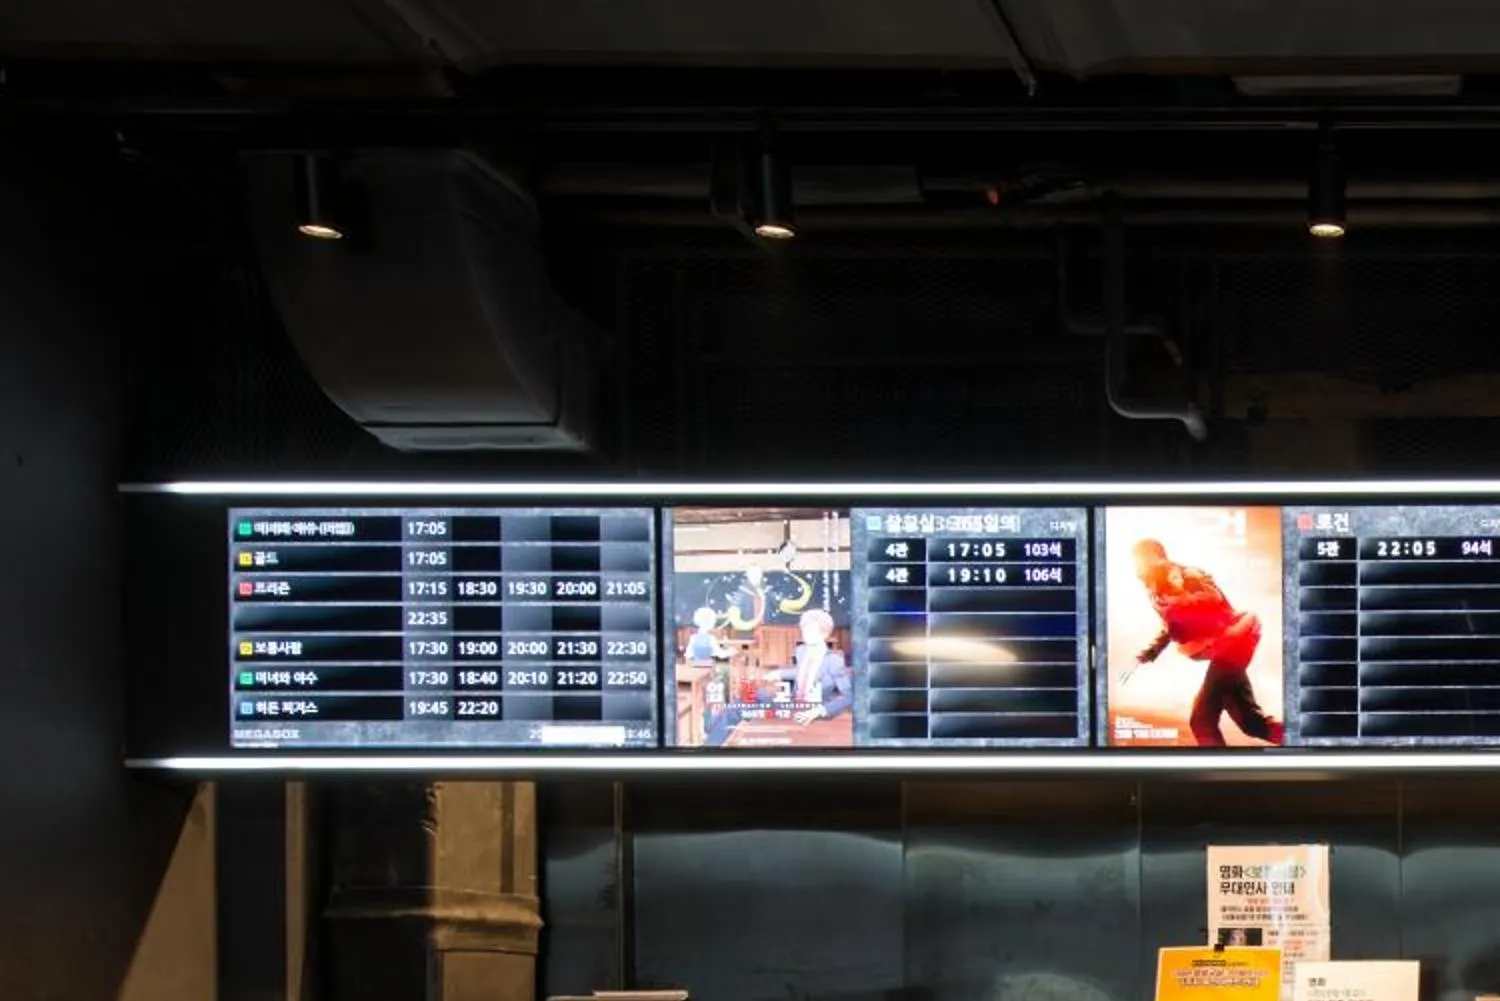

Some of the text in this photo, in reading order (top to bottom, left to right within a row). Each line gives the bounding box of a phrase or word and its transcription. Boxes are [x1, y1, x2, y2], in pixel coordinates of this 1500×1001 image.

[408, 521, 447, 535] 17:05
[948, 543, 1005, 557] 17:05
[1377, 541, 1436, 556] 22:05
[408, 551, 447, 565] 17:05
[948, 568, 1006, 582] 19:10
[408, 581, 447, 595] 17:15
[457, 581, 496, 595] 18:30
[508, 581, 547, 595] 19:30
[556, 581, 595, 595] 20:00
[606, 581, 645, 595] 21:05
[408, 611, 447, 625] 22:35
[409, 641, 448, 655] 17:30
[458, 641, 497, 655] 19:00
[508, 641, 547, 655] 20:00
[557, 641, 596, 655] 21:30
[607, 641, 646, 655] 22:30
[409, 671, 448, 685] 17:30
[458, 671, 497, 685] 18:40
[508, 671, 547, 685] 20:10
[557, 671, 596, 685] 21:20
[607, 671, 646, 685] 22:50
[409, 701, 448, 715] 19:45
[458, 701, 497, 715] 22:20
